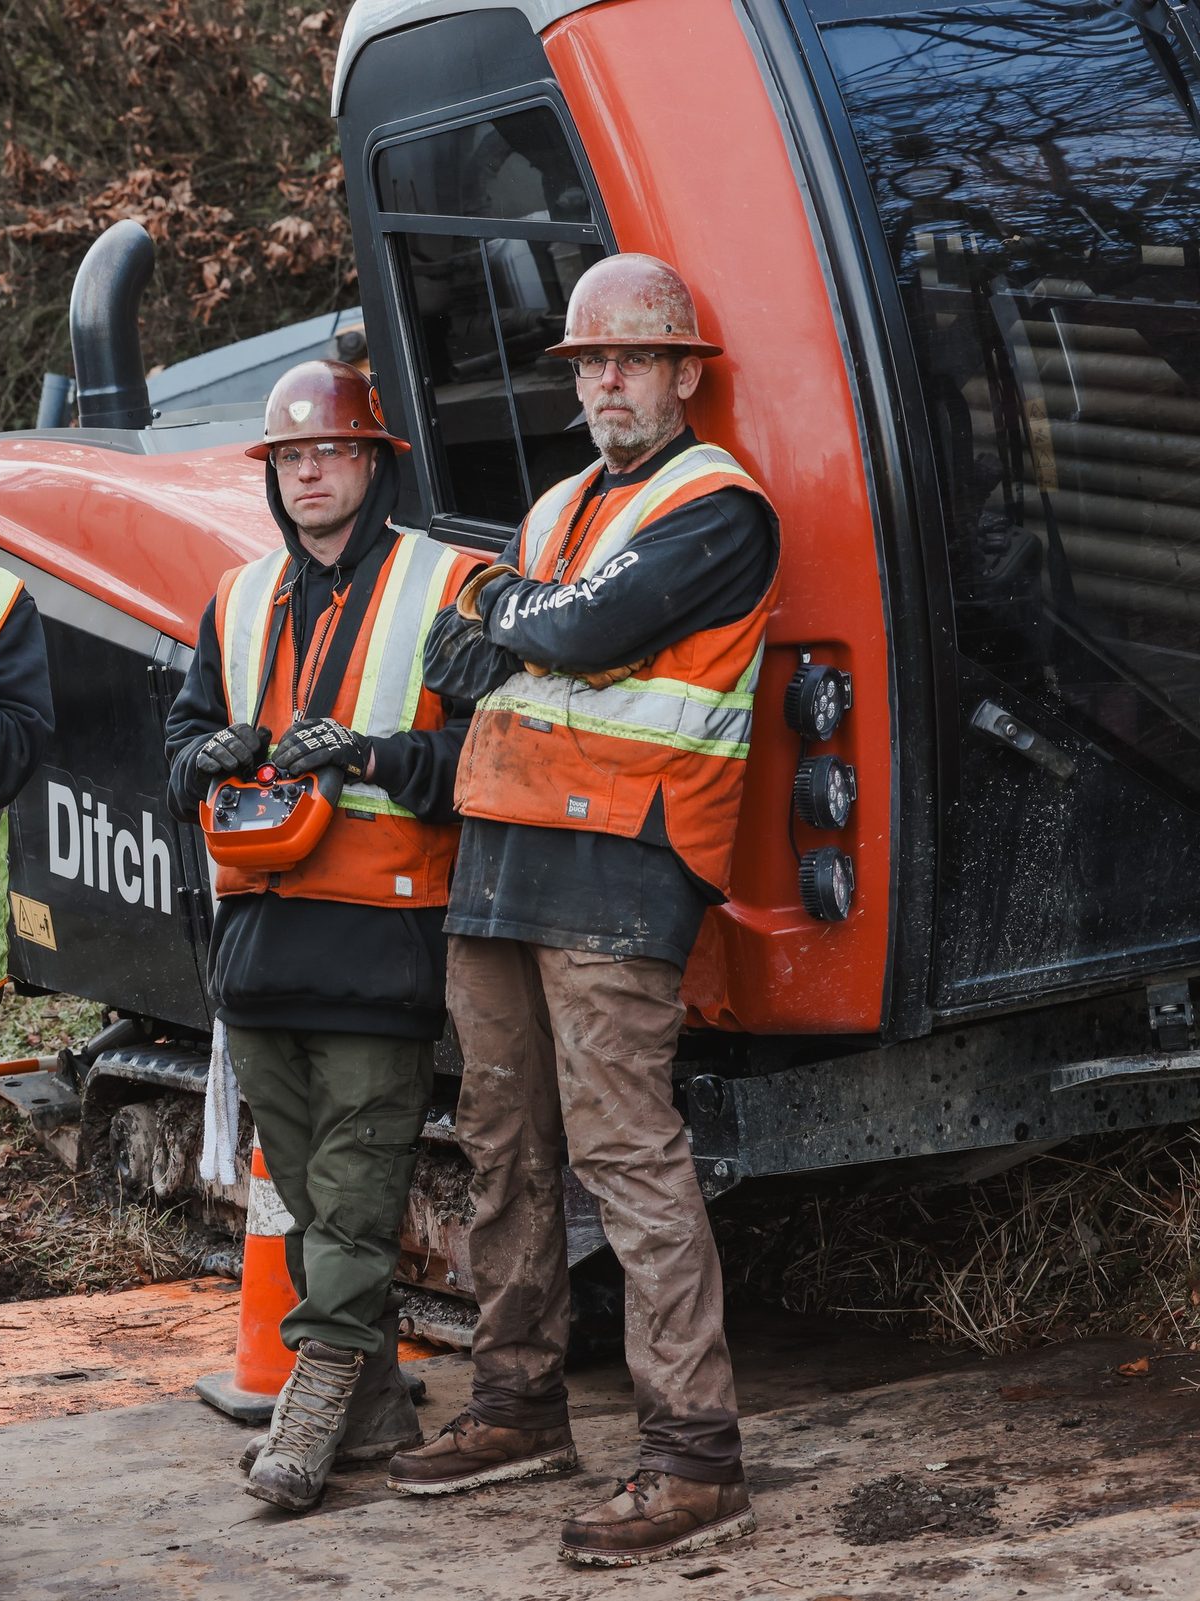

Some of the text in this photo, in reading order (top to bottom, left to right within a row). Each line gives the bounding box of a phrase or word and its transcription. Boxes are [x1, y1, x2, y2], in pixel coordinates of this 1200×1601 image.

[569, 799, 588, 808] TOUGH
[568, 805, 587, 815] DUCK
[48, 780, 172, 915] Ditch
